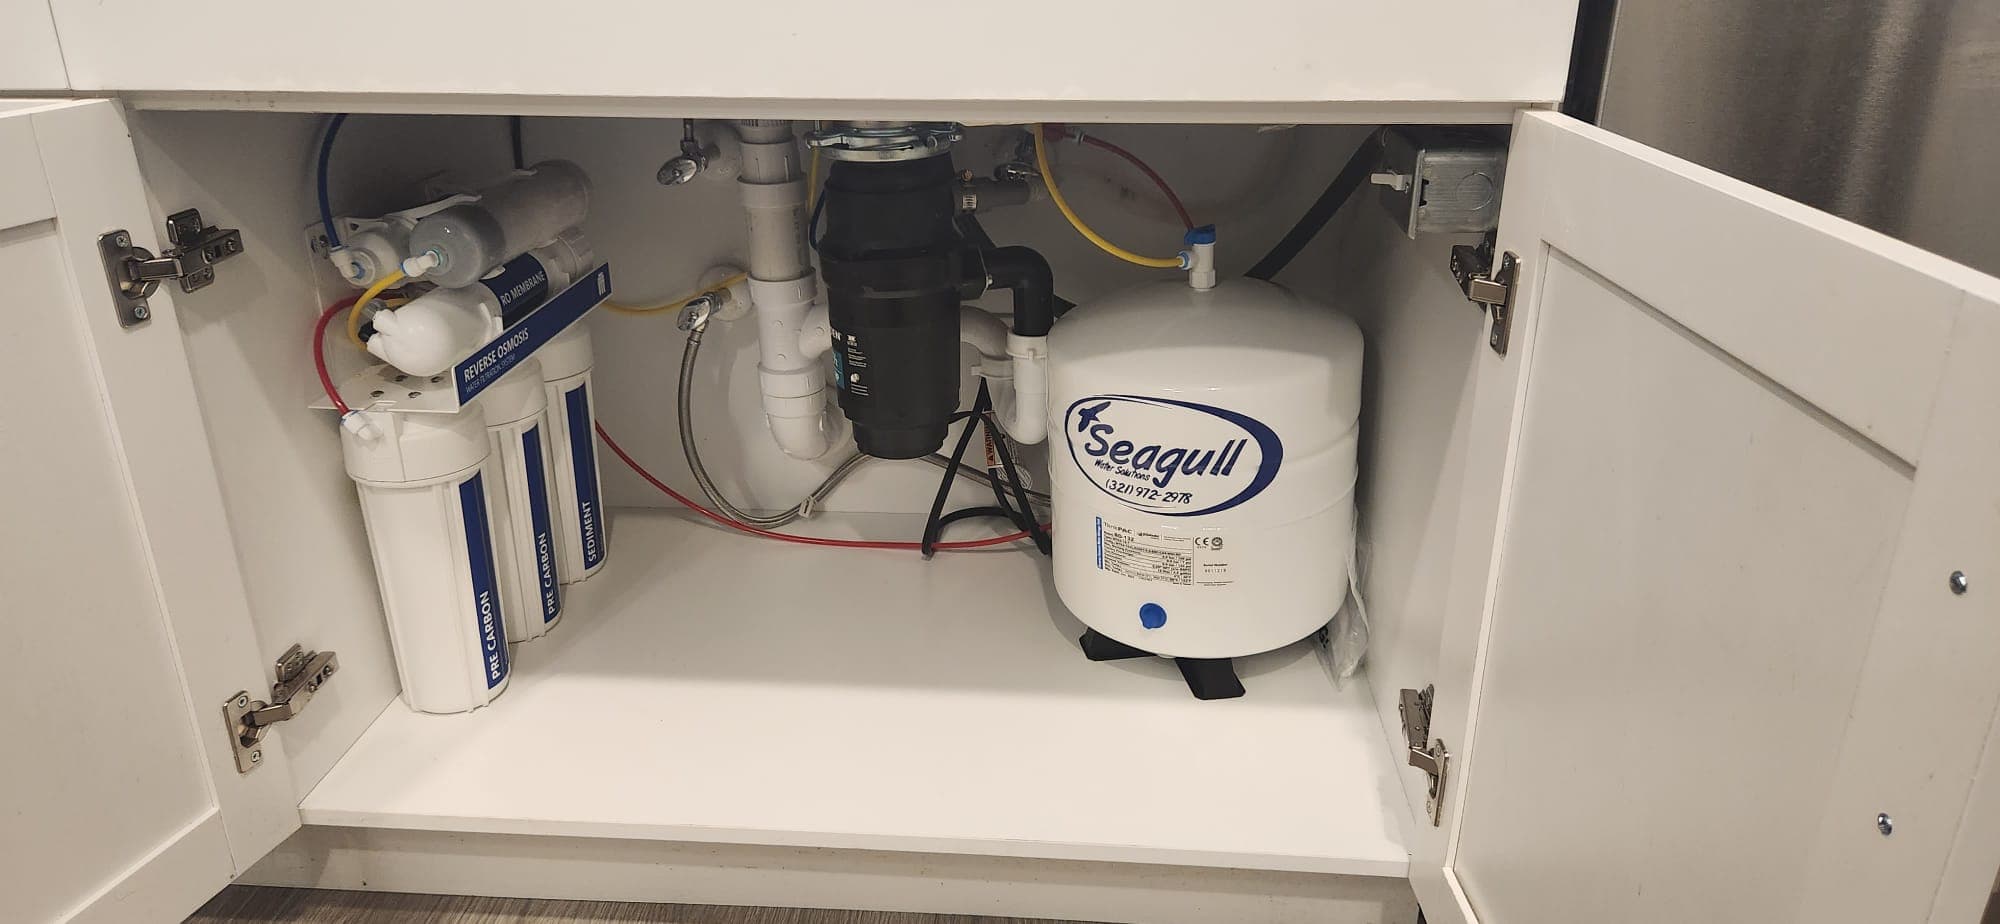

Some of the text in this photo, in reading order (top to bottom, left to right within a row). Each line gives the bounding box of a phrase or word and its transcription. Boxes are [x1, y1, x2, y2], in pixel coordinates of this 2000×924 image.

[501, 271, 546, 307] RO MEMBRANE
[463, 328, 529, 383] REVERSE OSMOSIS
[465, 379, 480, 393] WATER
[1084, 424, 1248, 488] Seagull
[1094, 458, 1151, 482] Water Solutions
[1105, 478, 1134, 496] (321)
[582, 501, 597, 562] SEDIMENT
[537, 532, 556, 615] PRE CARBON
[479, 590, 501, 681] PRE CARBON
